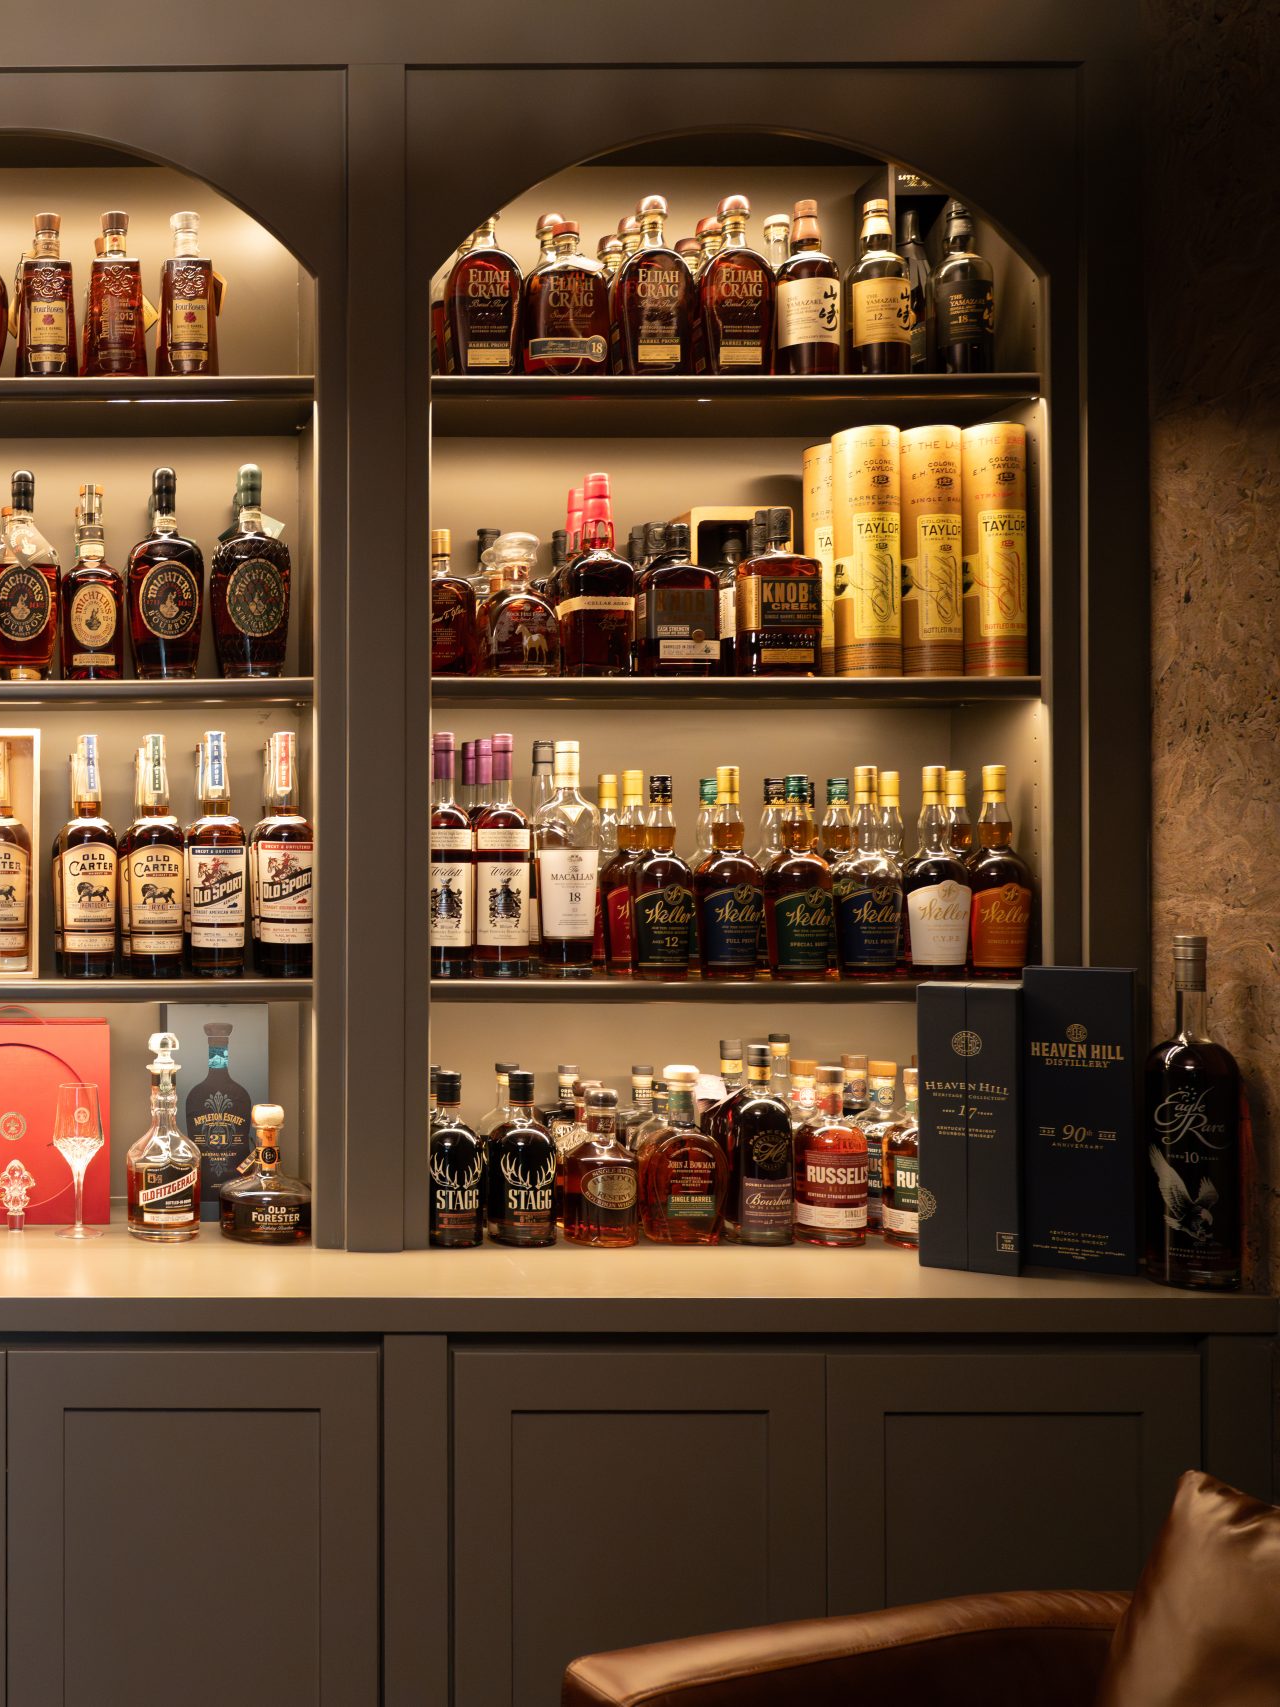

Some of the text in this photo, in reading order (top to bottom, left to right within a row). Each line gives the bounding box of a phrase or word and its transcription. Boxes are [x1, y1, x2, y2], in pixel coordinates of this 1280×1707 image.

[470, 269, 510, 283] ELIJAH
[638, 269, 679, 283] ELIJAH
[721, 269, 763, 283] ELIJAH
[469, 284, 509, 299] CRAIG
[549, 278, 594, 292] ELIJAH
[637, 283, 679, 299] CRAIG
[720, 283, 762, 298] CRAIG
[549, 292, 593, 307] CRAIG
[115, 312, 133, 320] 2013
[874, 313, 883, 321] 12
[958, 315, 968, 323] 18
[591, 342, 603, 353] 18
[855, 440, 876, 449] THE
[918, 441, 940, 449] THE
[978, 438, 1000, 447] THE
[857, 523, 899, 534] TAYLOR
[922, 525, 961, 536] TAYLOR
[983, 521, 1026, 532] TAYLOR
[0, 573, 44, 602] MICHTER'S
[147, 572, 191, 600] MICHTER'S
[763, 582, 808, 603] KNOB
[75, 592, 111, 616] MICHTER'S
[1, 612, 44, 632] BOURBON
[149, 610, 191, 631] BOURBON
[69, 861, 113, 877] CARTER
[134, 862, 179, 878] CARTER
[569, 865, 579, 873] The
[551, 873, 594, 881] MACALLAN
[194, 875, 242, 904] OLD SPORT
[263, 871, 311, 899] OLD SPORT
[223, 895, 240, 905] KENTUCKY
[569, 892, 580, 902] 18
[645, 900, 690, 924] Weller
[715, 900, 760, 923] Weller
[786, 903, 831, 926] Weller
[853, 900, 901, 923] Weller
[920, 899, 969, 920] Weller
[981, 900, 1029, 923] Weller
[665, 937, 678, 947] 12
[1031, 1041, 1124, 1061] HEAVEN HILL
[1045, 1058, 1109, 1068] DISTILLERY
[925, 1081, 1009, 1095] HEAVEN HILL
[1154, 1090, 1206, 1131] Eagle
[194, 1112, 243, 1125] APPLETON ESTATE
[210, 1135, 228, 1144] 21
[1063, 1124, 1093, 1143] 90th
[1051, 1141, 1104, 1150] ANNIVERSARY
[668, 1160, 684, 1169] JOHN
[690, 1160, 716, 1169] BOWMAN
[1184, 1151, 1199, 1164] 10
[142, 1171, 197, 1203] OLD FITZGERALD
[436, 1189, 479, 1210] STAGG
[508, 1189, 552, 1210] STAGG
[597, 1192, 631, 1202] RESERVE
[747, 1189, 791, 1206] Bourbon
[252, 1212, 300, 1222] FORESTER
[268, 1206, 286, 1214] OLD
[845, 1210, 860, 1219] SINGLE
[1081, 1231, 1109, 1239] STRAIGHT
